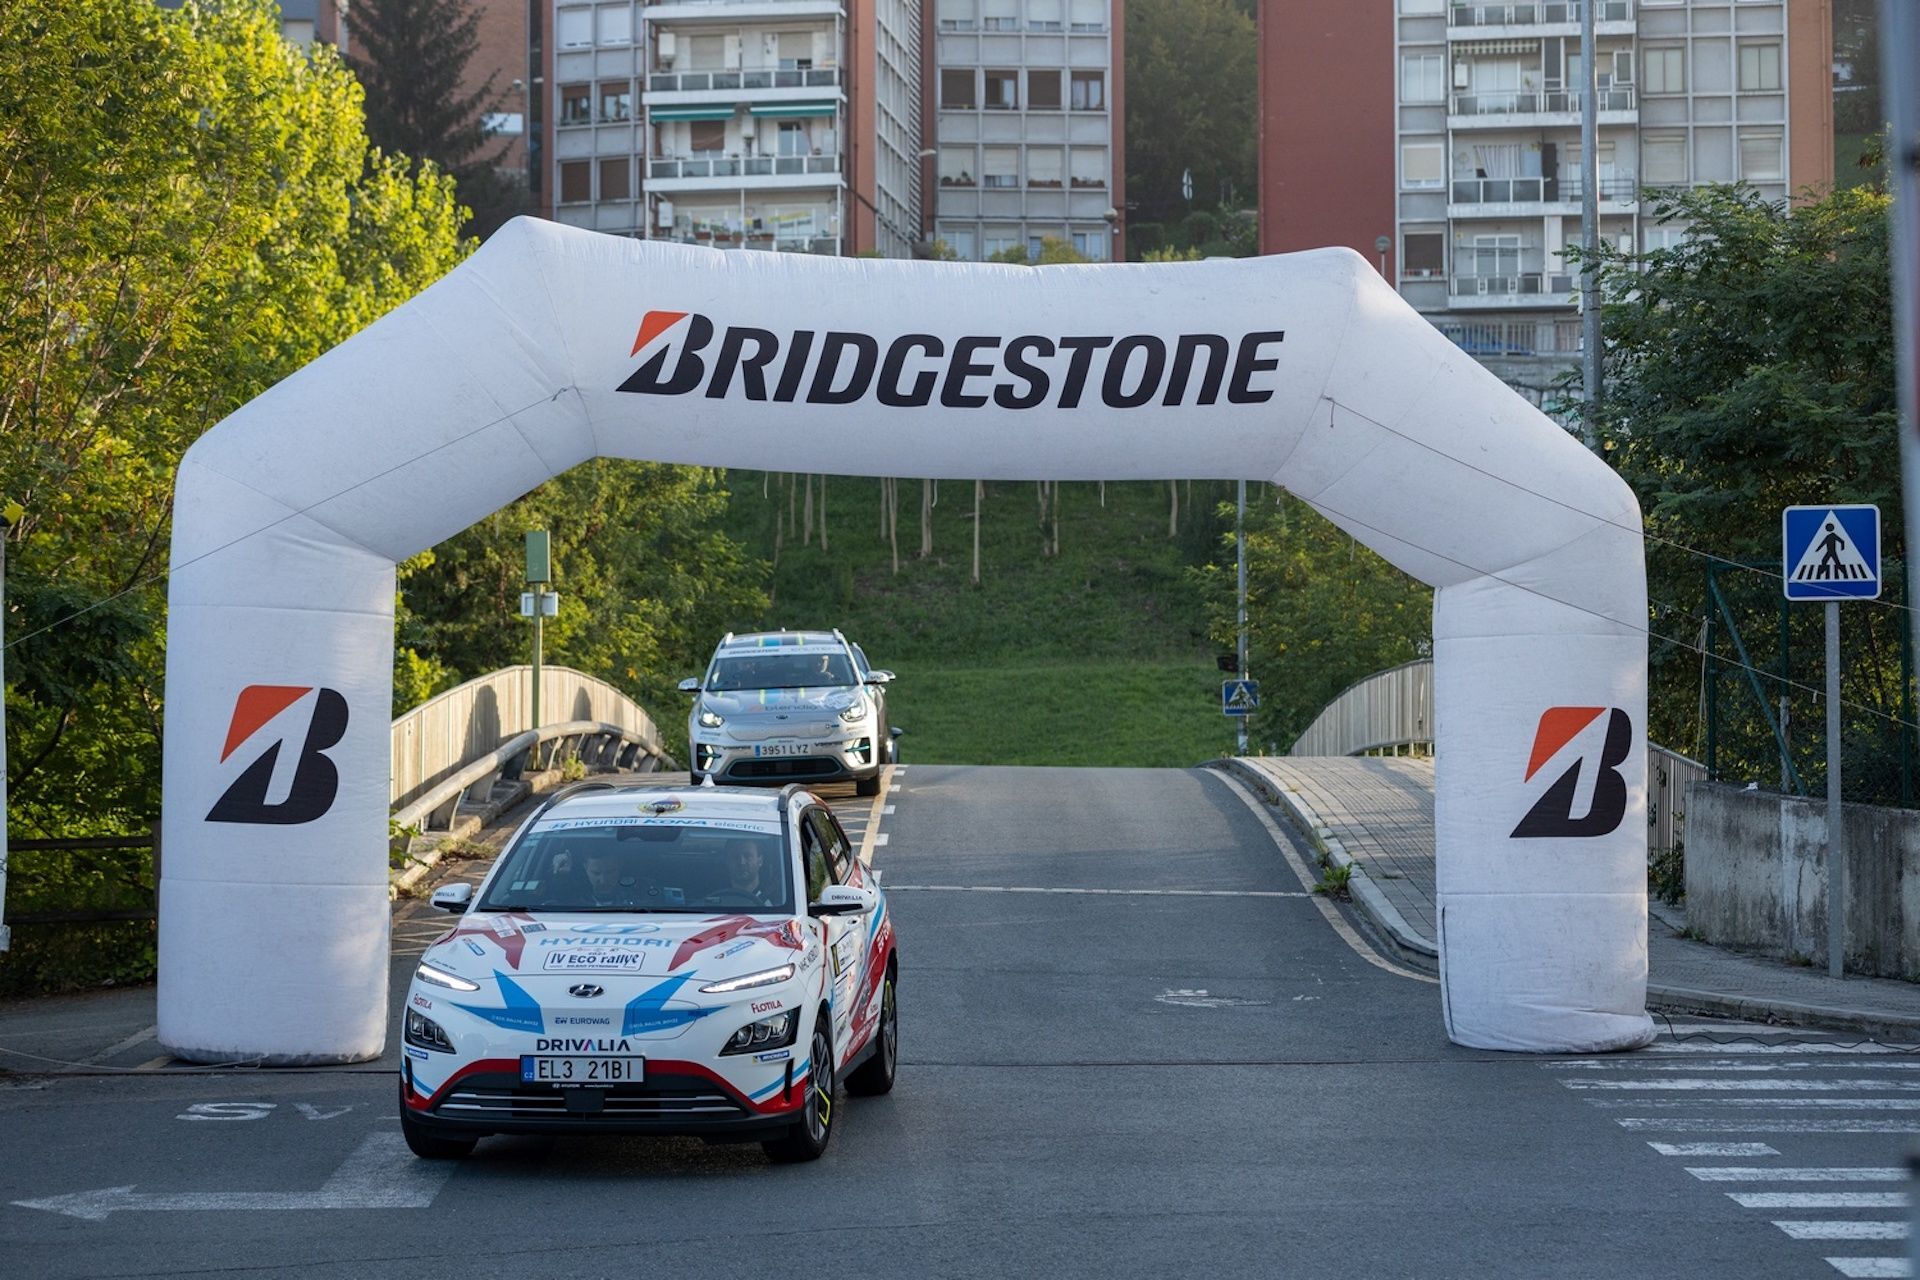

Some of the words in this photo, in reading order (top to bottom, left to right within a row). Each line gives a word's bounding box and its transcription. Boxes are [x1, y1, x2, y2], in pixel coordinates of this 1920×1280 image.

[615, 310, 1285, 409] BRIDGESTONE
[762, 745, 786, 755] 3951
[789, 744, 809, 754] LYZ
[574, 819, 638, 827] HYUNDAI
[642, 818, 707, 826] KONA
[714, 821, 765, 832] electric
[539, 937, 673, 949] HYUNDAI
[550, 953, 566, 964] IV
[570, 1017, 610, 1025] EUROWAG
[536, 1039, 631, 1052] DRIVALIA
[538, 1060, 573, 1079] EL3
[588, 1060, 632, 1080] 21BI
